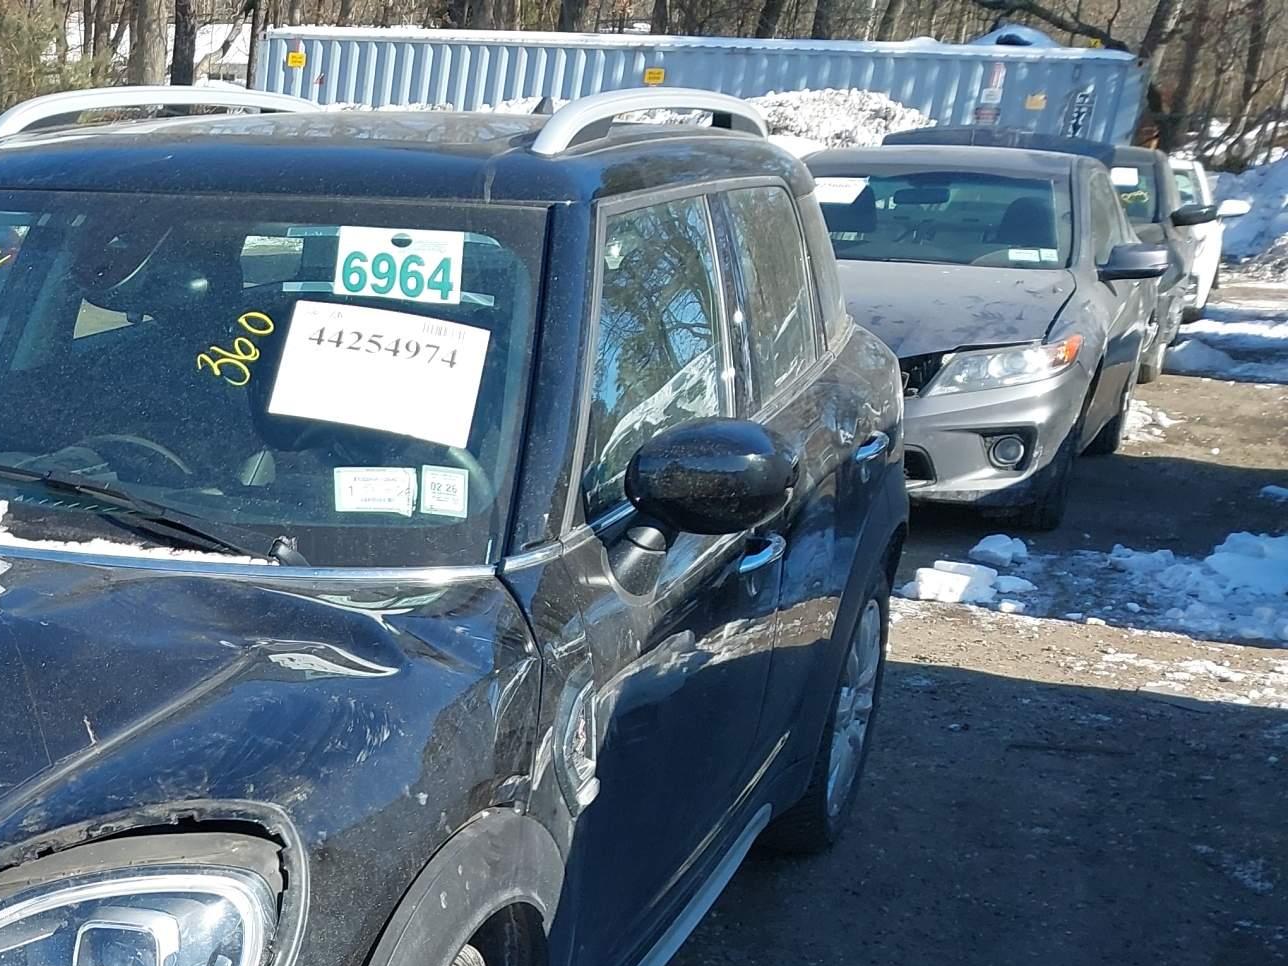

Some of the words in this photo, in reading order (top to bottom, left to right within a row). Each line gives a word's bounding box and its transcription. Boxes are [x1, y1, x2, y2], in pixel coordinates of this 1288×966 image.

[342, 251, 454, 300] 6964
[197, 311, 275, 386] 360
[307, 326, 458, 369] 44254974
